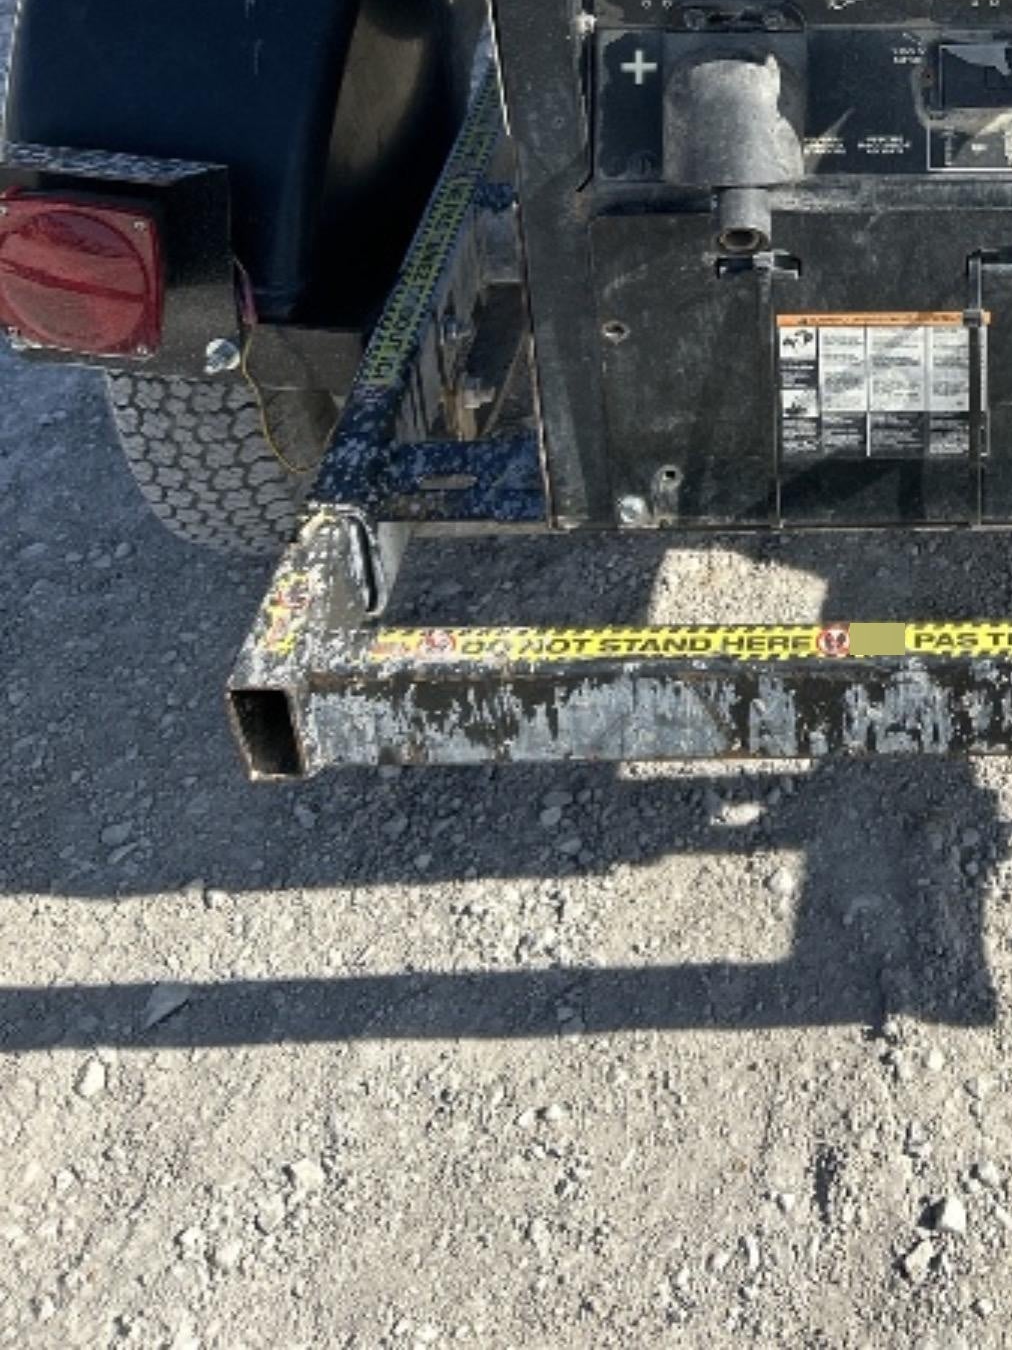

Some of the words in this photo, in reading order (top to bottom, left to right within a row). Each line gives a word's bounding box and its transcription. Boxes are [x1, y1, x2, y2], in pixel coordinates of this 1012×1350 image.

[597, 636, 714, 653] STAND
[719, 635, 812, 652] HERE
[913, 633, 980, 650] PAS
